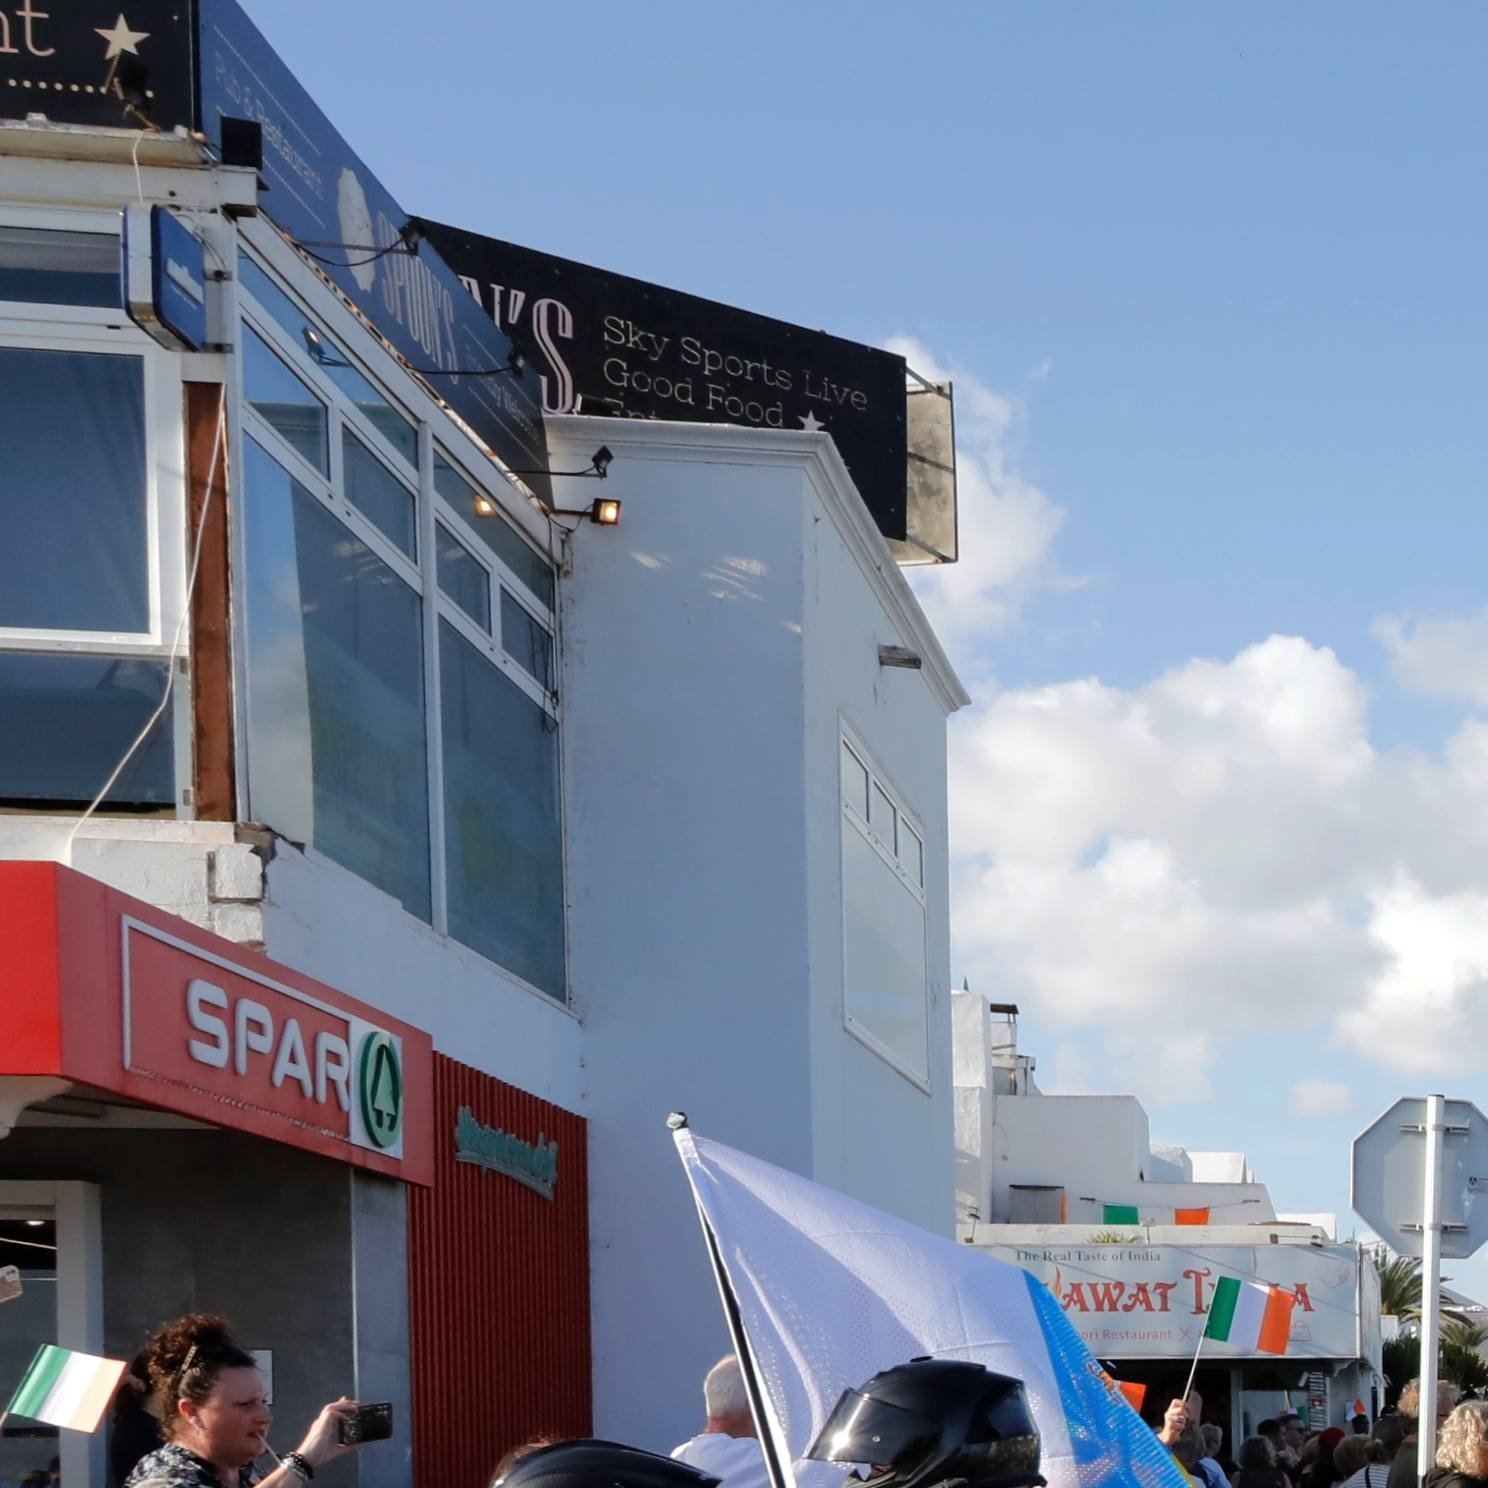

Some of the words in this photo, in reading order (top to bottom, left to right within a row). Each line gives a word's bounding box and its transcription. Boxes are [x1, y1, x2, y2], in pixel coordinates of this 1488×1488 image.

[603, 315, 670, 361] Sky
[681, 336, 793, 391] Sports
[802, 369, 868, 411] Live
[603, 357, 695, 405] Good
[706, 383, 784, 427] Food
[186, 977, 351, 1112] SPAR
[1016, 1250, 1040, 1262] The
[1043, 1250, 1071, 1262] Real
[1077, 1250, 1106, 1262] Taste
[1112, 1250, 1126, 1262] of
[1128, 1250, 1161, 1262] India
[1044, 1281, 1178, 1313] AWAT
[1102, 1329, 1172, 1340] Restaurant
